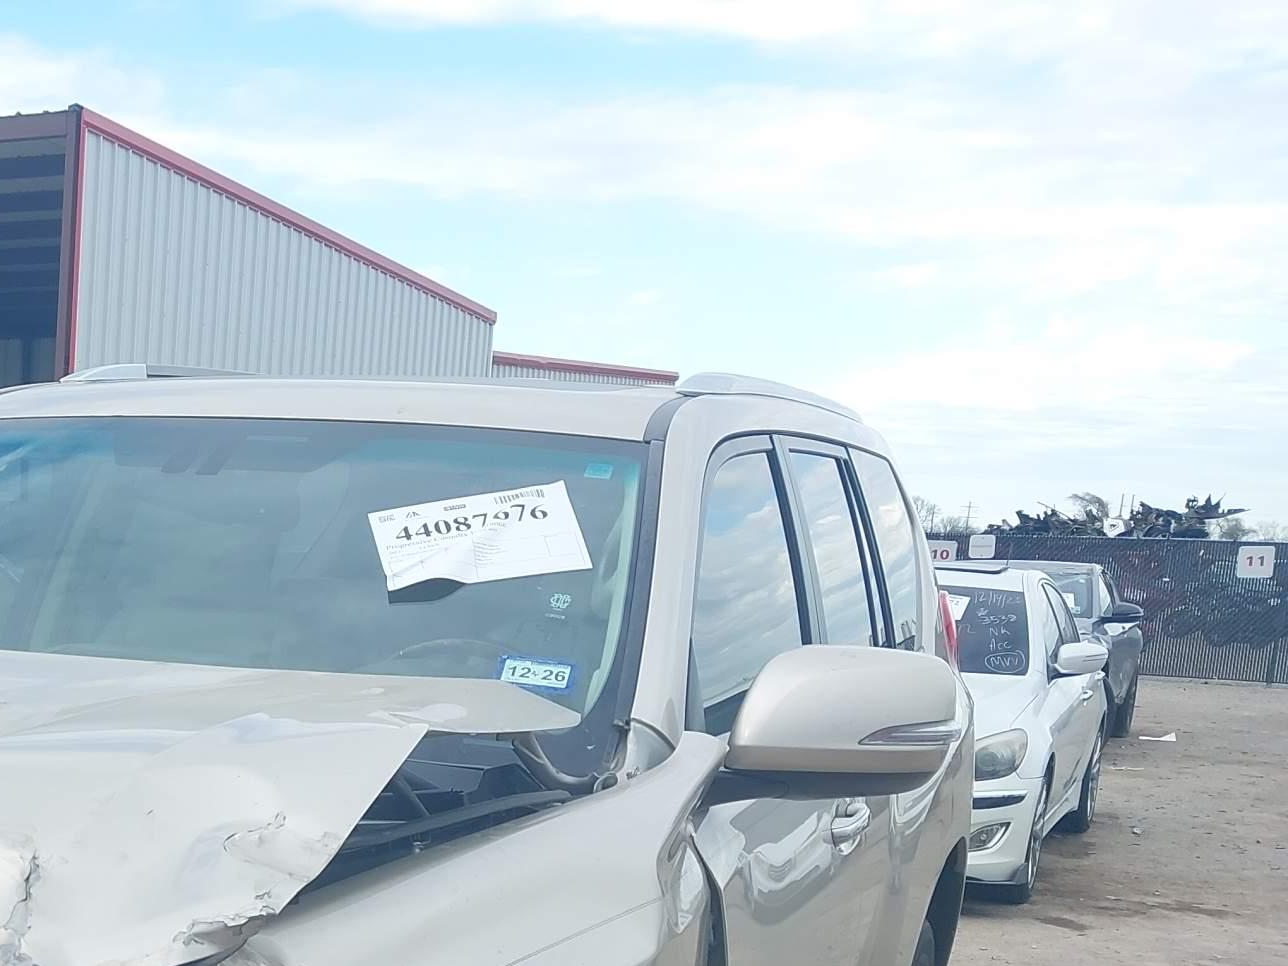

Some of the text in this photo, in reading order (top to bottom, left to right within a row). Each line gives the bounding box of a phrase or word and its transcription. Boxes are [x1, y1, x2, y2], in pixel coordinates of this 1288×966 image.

[930, 549, 950, 560] 10
[1246, 555, 1265, 567] 11
[508, 665, 568, 682] 12 26
